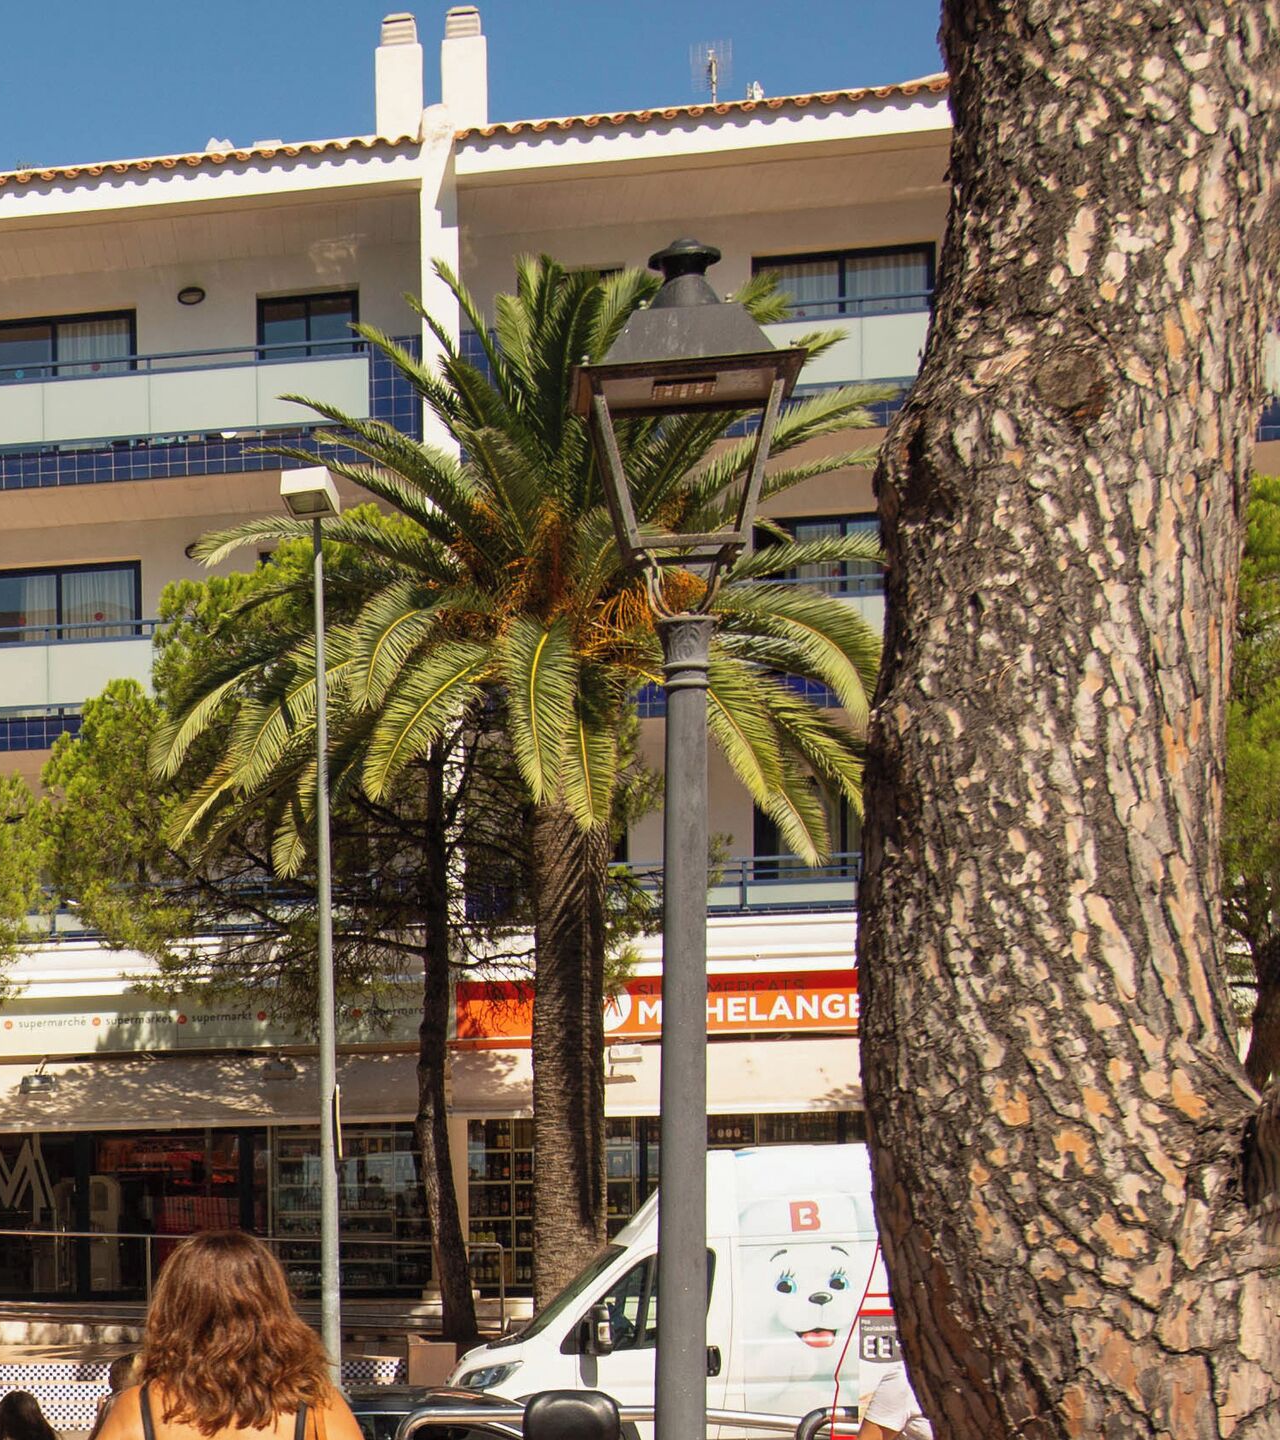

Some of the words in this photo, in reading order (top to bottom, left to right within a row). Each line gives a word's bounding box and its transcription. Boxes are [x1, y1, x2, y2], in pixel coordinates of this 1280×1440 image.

[636, 979, 806, 997] SUMERCATS
[105, 1014, 173, 1027] supermarket
[191, 1011, 252, 1025] supermarkt
[637, 993, 860, 1025] MHELANGE
[789, 1200, 822, 1233] B
